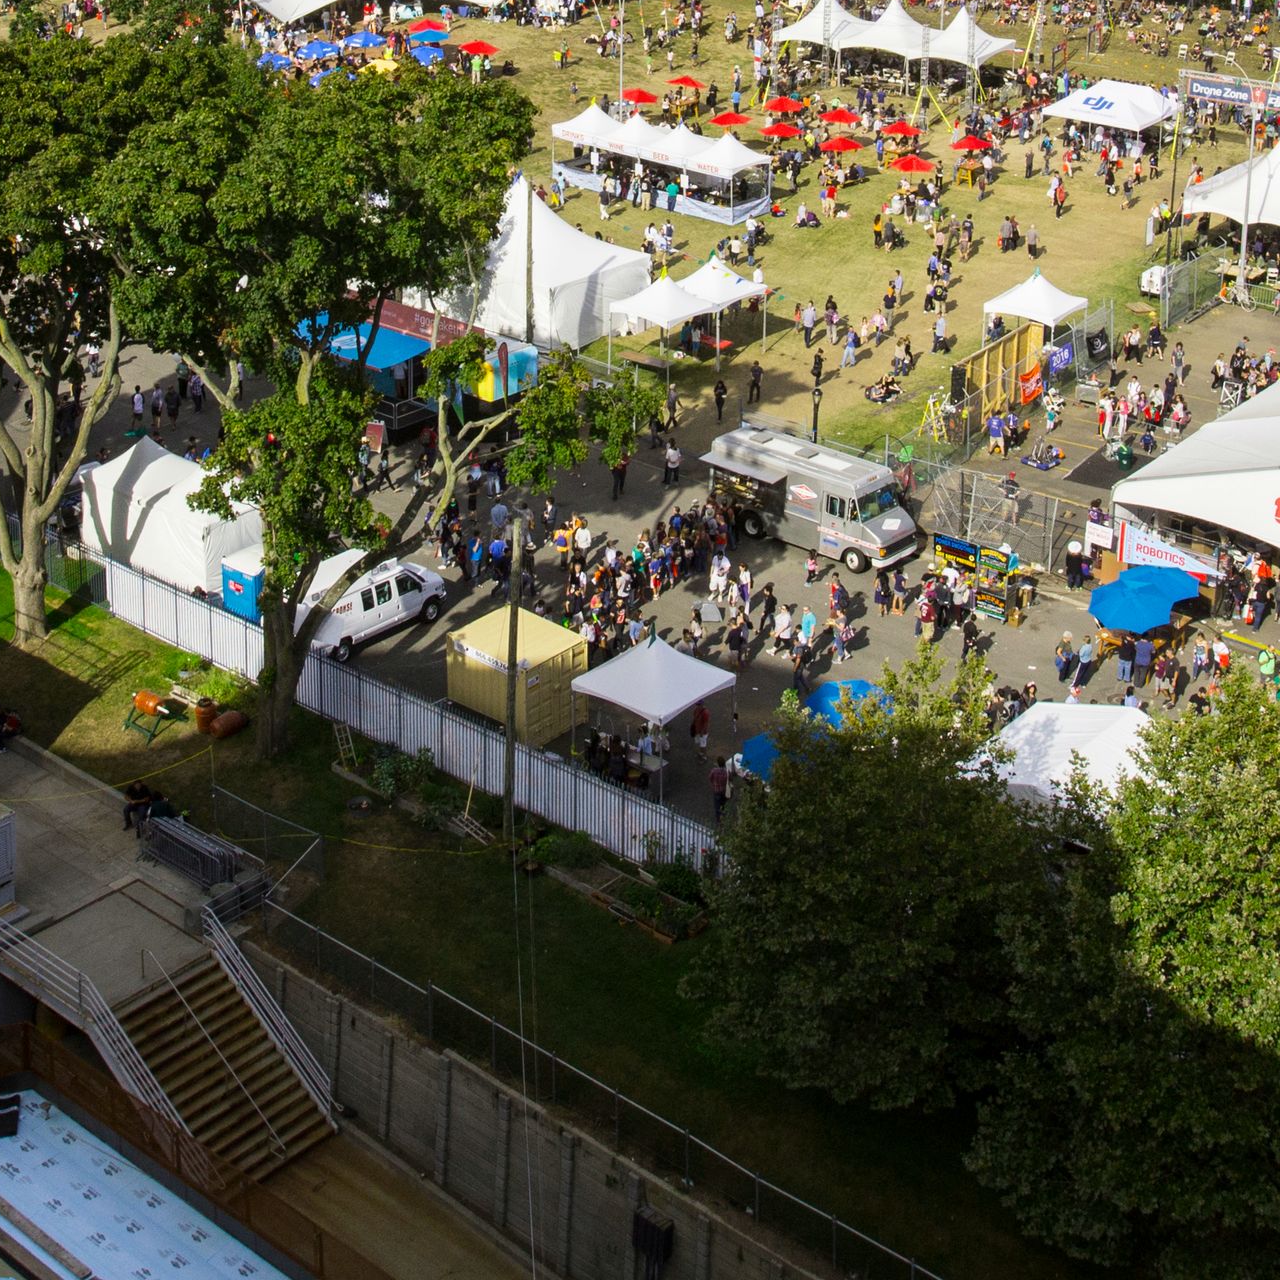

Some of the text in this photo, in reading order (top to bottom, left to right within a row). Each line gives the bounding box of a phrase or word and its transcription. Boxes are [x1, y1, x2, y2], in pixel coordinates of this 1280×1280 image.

[1192, 82, 1249, 101] Drone Zone
[1082, 96, 1115, 111] dji
[561, 129, 585, 141] DRINKS
[609, 142, 625, 152] WINE
[652, 151, 670, 161] BEER
[696, 163, 719, 173] WATER
[1052, 348, 1070, 367] 2016
[1135, 543, 1185, 567] ROBOTICS
